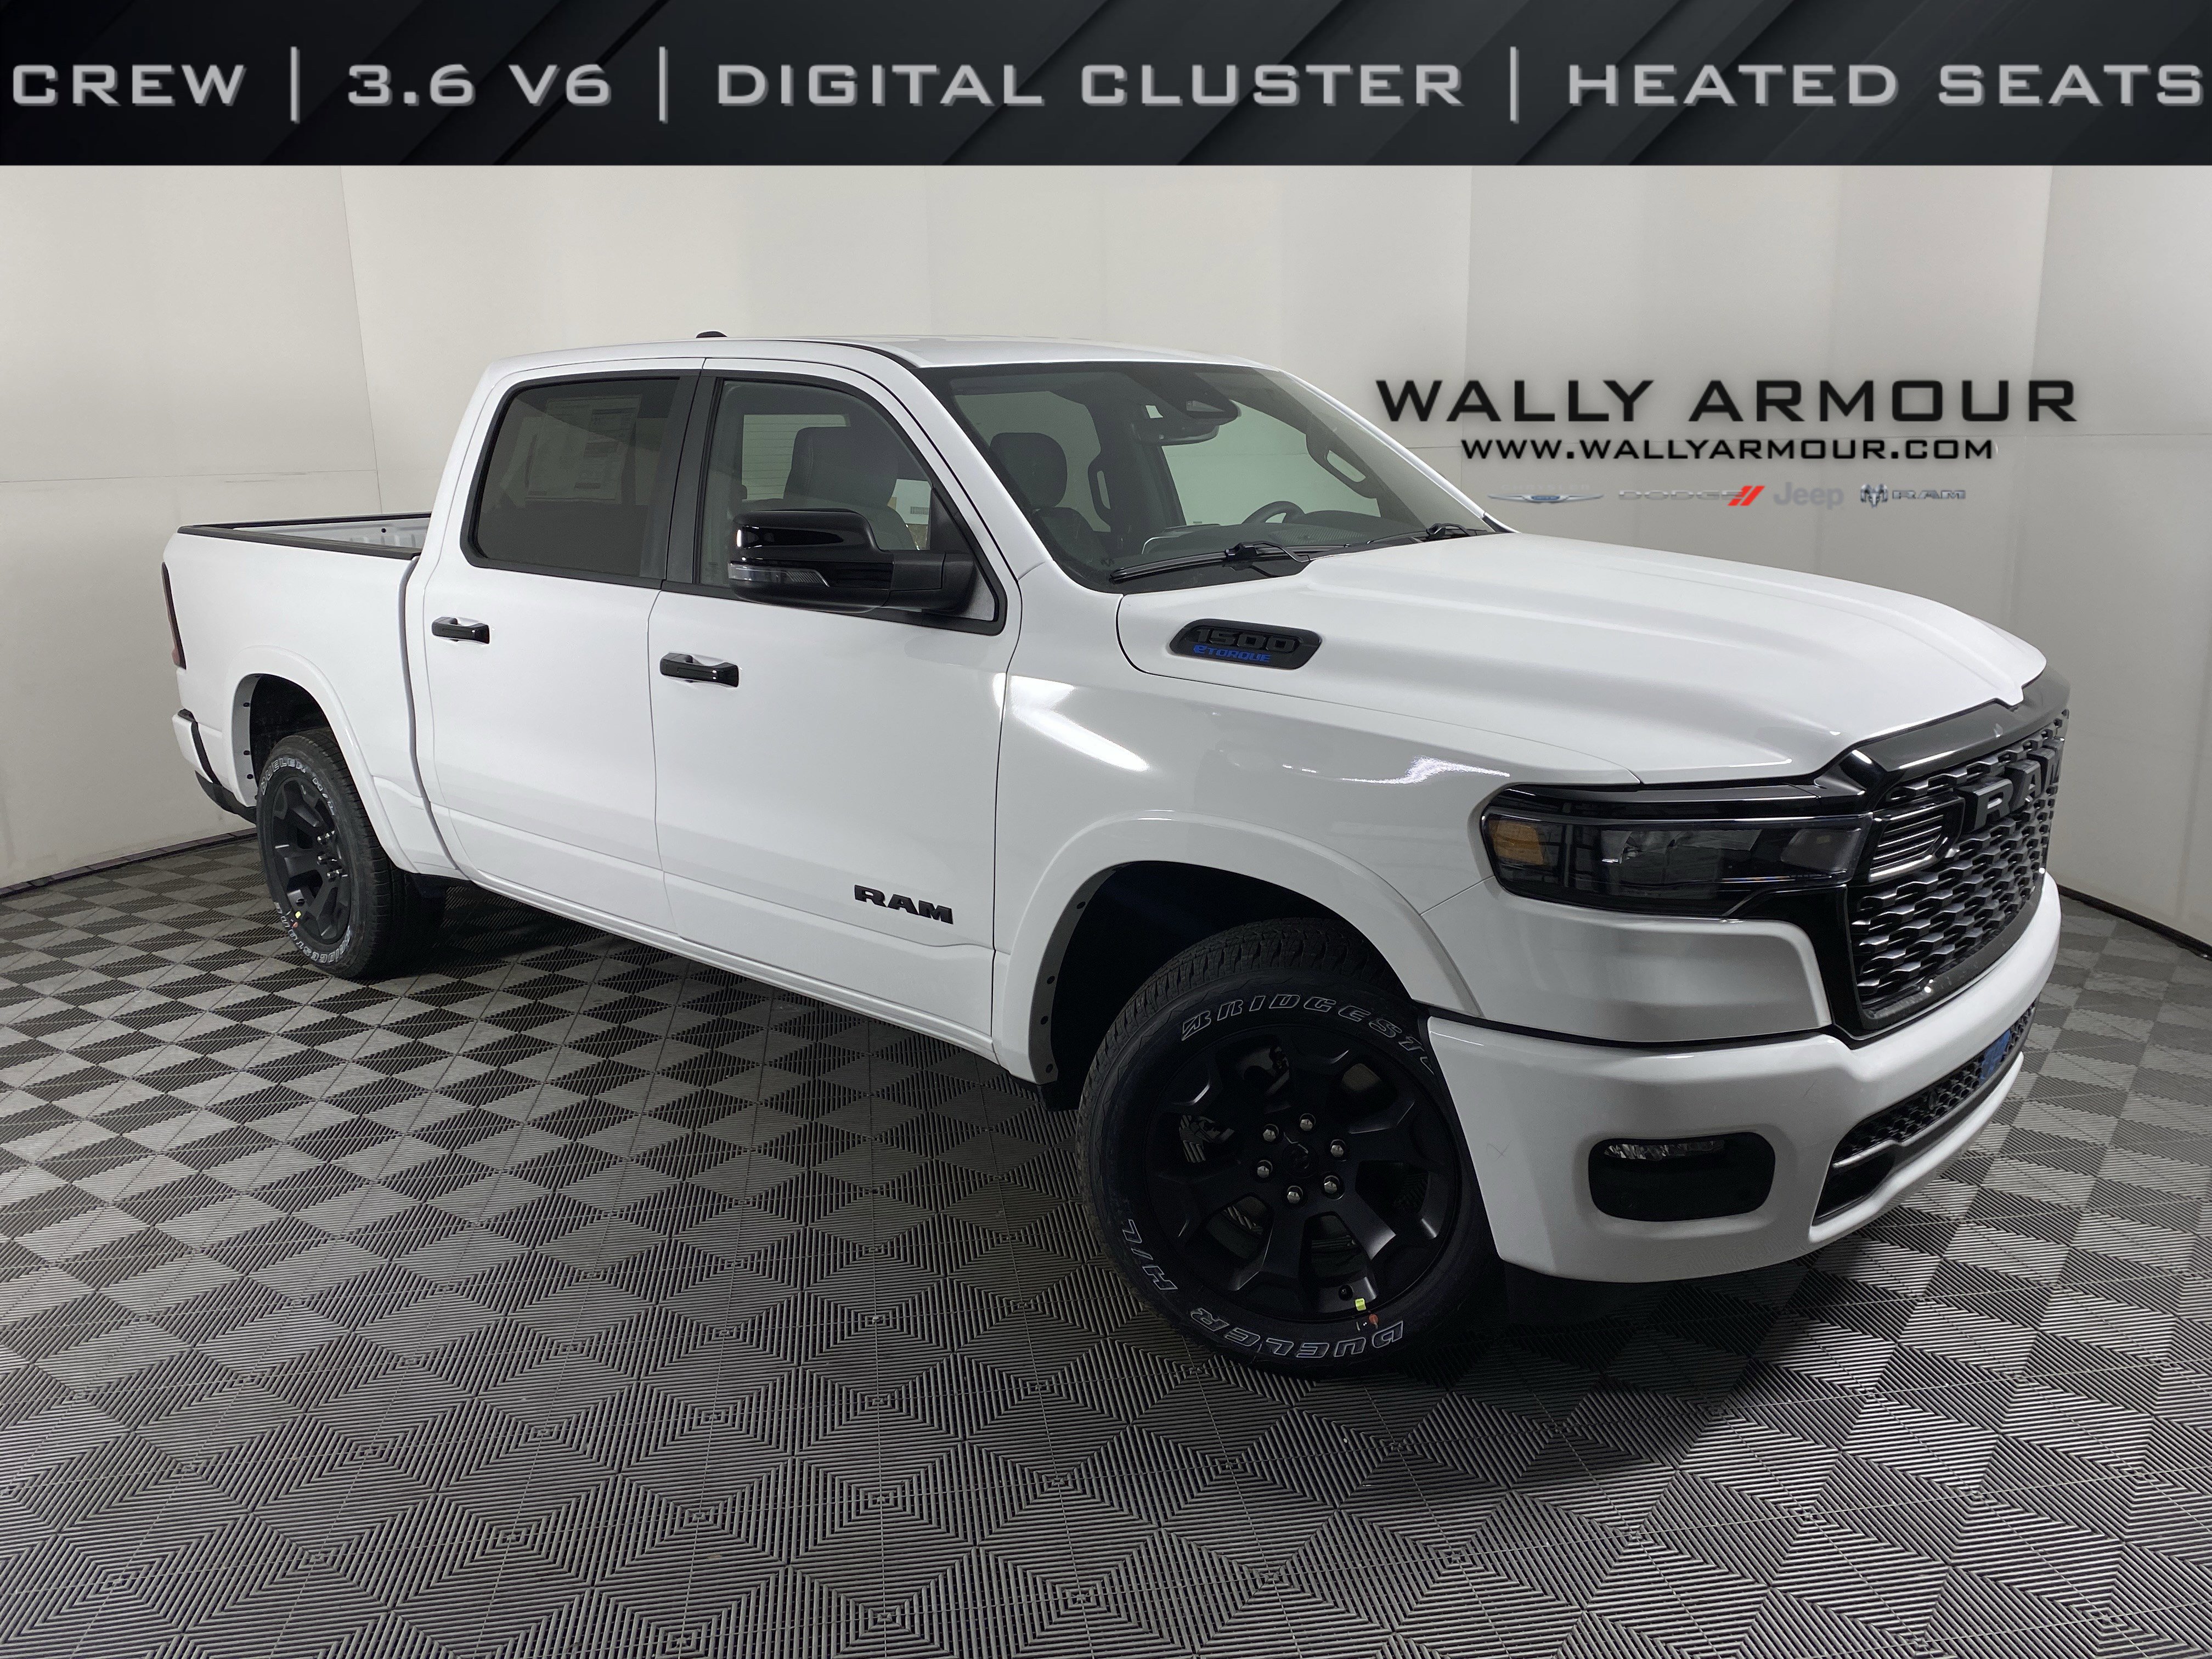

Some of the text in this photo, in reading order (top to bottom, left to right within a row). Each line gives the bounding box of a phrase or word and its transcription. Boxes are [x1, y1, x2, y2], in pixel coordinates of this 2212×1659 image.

[1196, 628, 1297, 653] 1500
[261, 758, 306, 796] DUELER
[854, 884, 954, 925] RAM
[1190, 1307, 1404, 1359] DUELER
